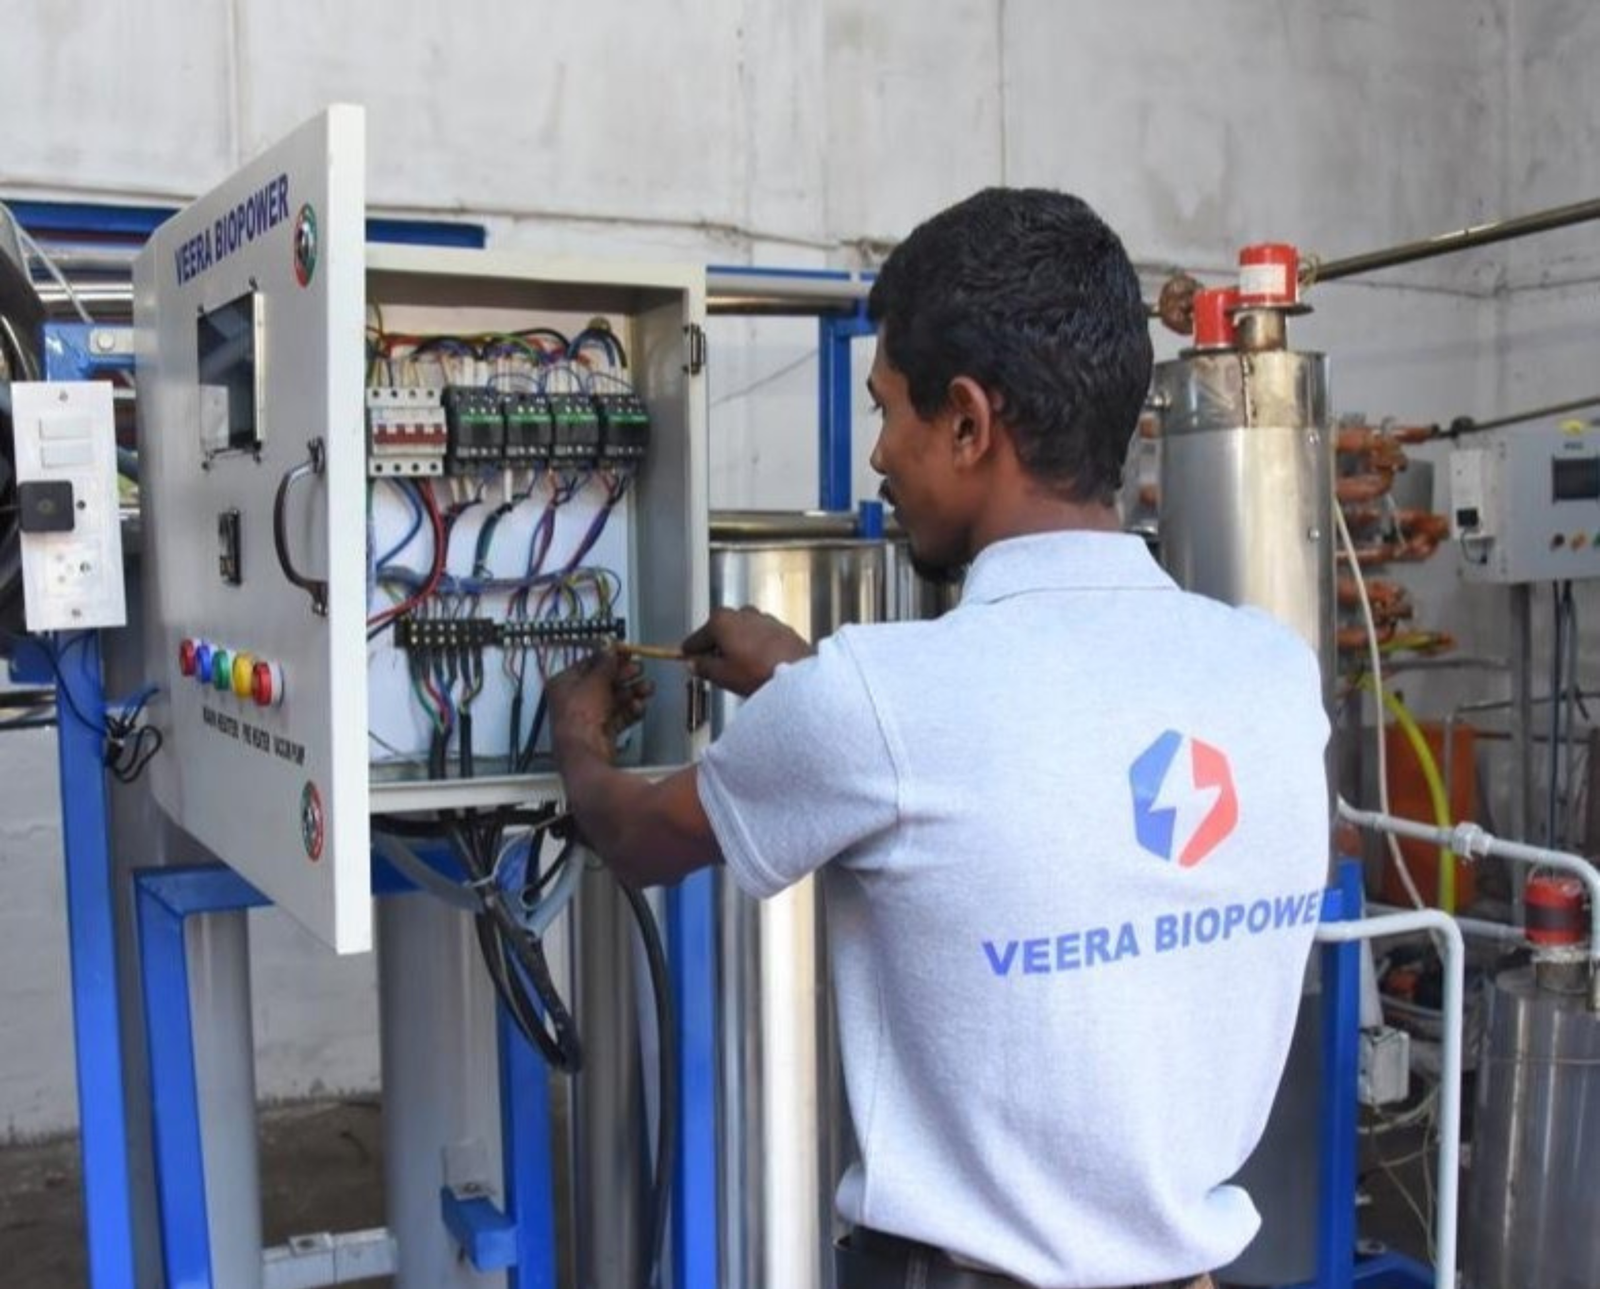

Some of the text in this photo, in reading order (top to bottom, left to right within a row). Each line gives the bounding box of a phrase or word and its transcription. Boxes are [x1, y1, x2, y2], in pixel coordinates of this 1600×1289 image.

[175, 172, 289, 287] VEERA BIOPOWER
[981, 890, 1322, 977] VEERA BIOPOWE
